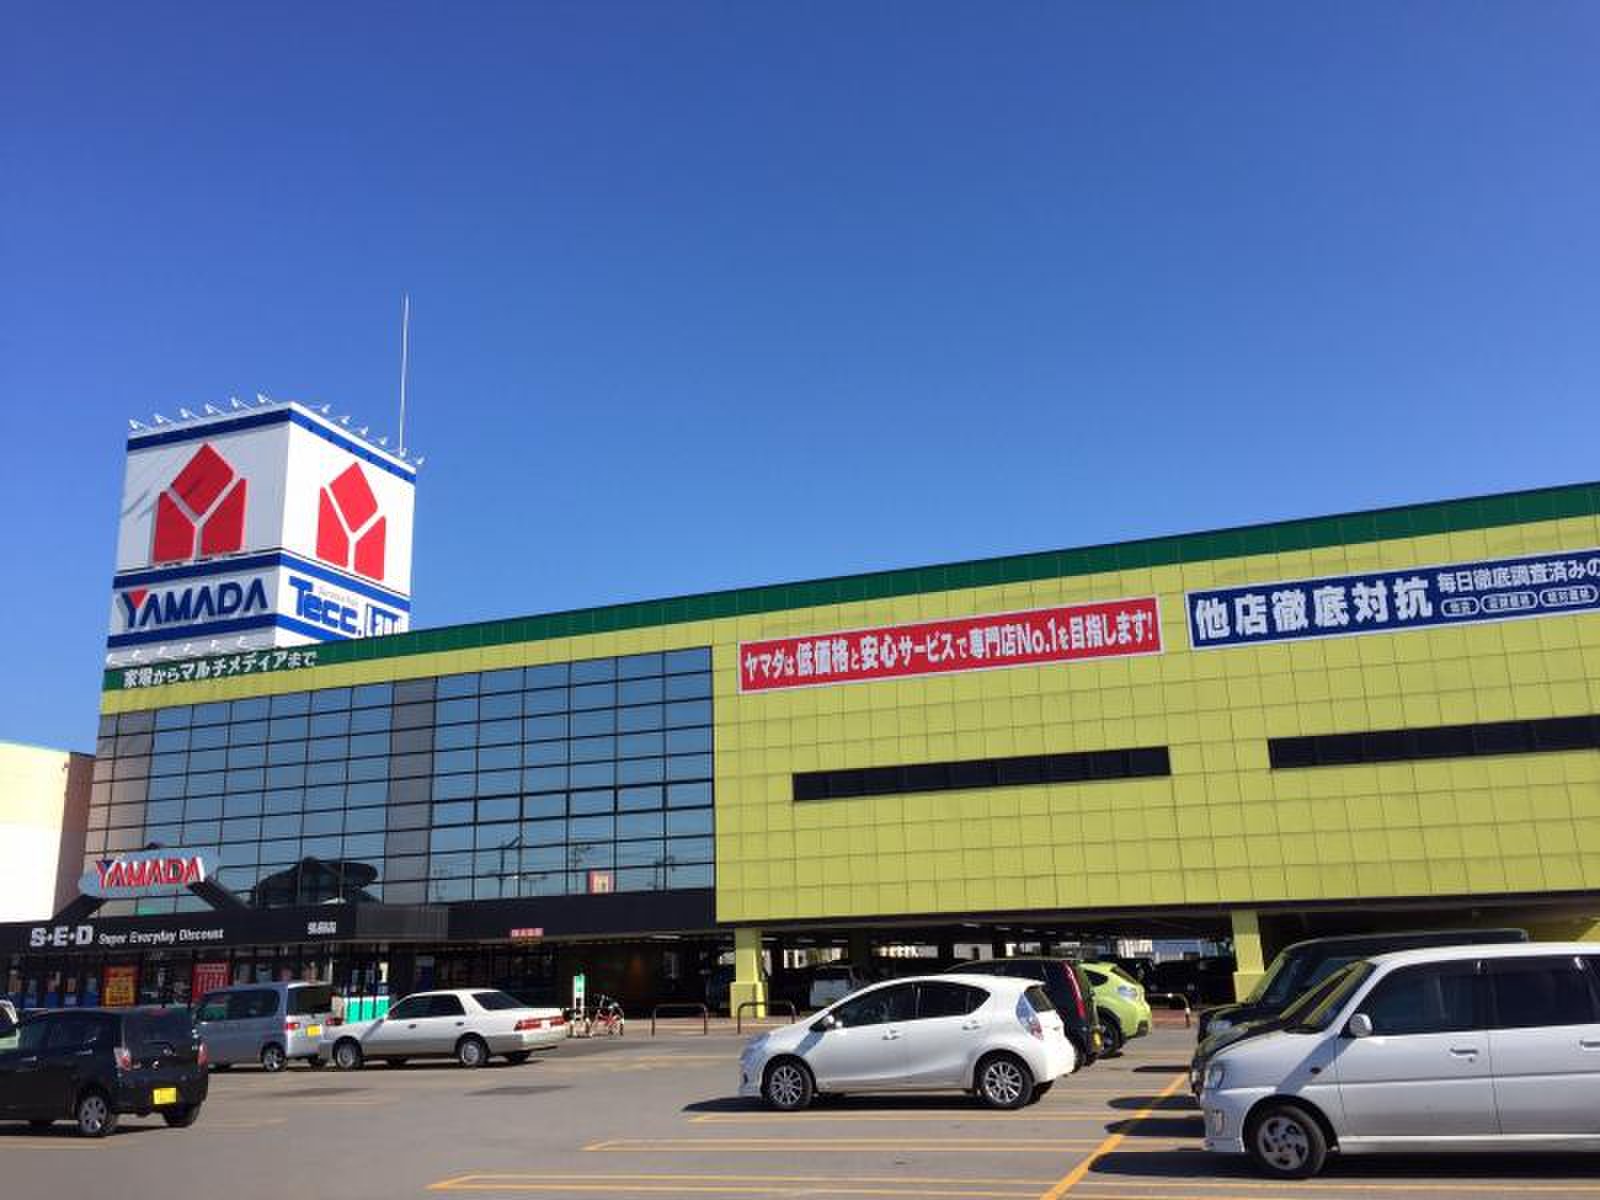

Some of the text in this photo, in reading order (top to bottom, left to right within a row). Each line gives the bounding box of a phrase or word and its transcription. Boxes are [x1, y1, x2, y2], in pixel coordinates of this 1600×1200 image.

[120, 577, 269, 629] YAMADA
[1195, 576, 1433, 641] 他店徹底対抗
[96, 856, 203, 889] YAMADA
[129, 930, 177, 946] Everyday
[178, 928, 225, 943] Discount
